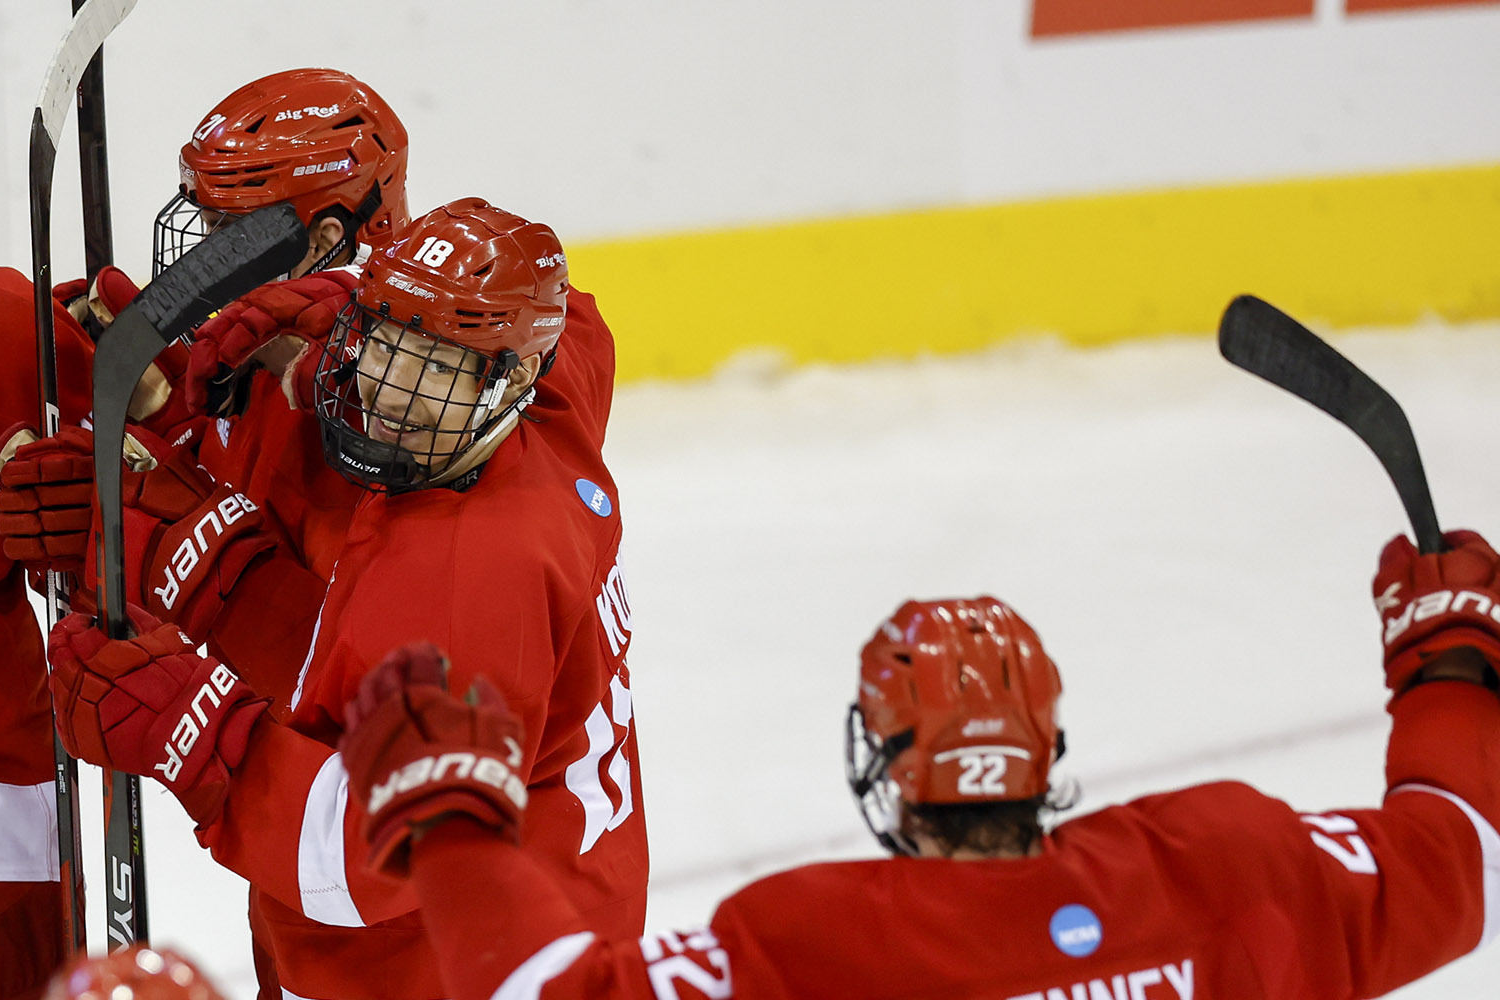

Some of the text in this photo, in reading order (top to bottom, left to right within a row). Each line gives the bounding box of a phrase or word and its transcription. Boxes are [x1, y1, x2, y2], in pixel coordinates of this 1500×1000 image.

[275, 110, 303, 123] Big
[412, 236, 455, 269] 18
[958, 755, 1006, 795] 22
